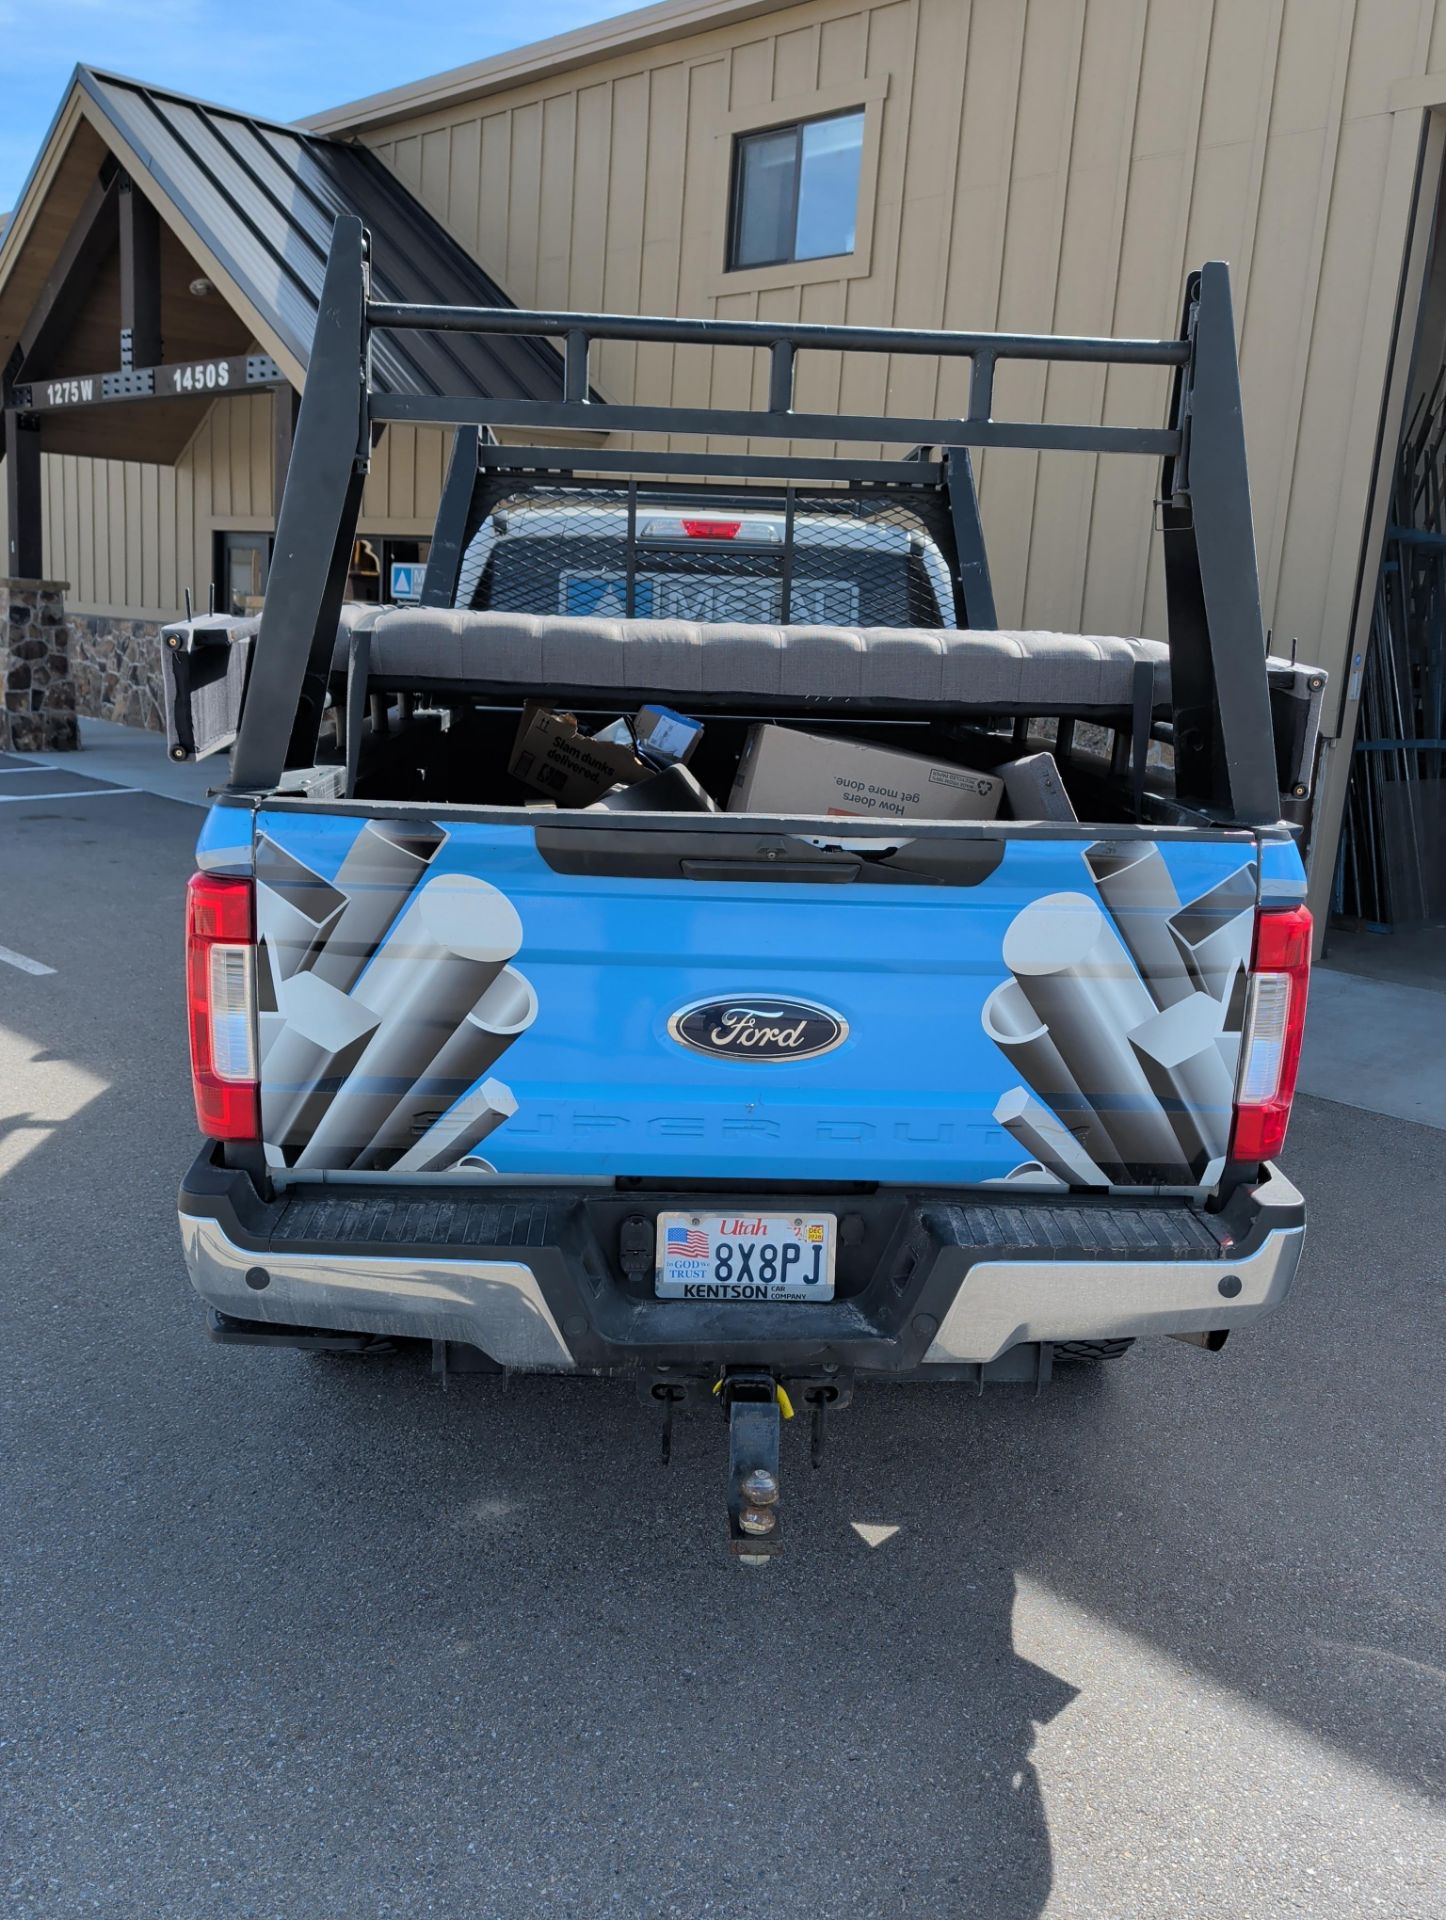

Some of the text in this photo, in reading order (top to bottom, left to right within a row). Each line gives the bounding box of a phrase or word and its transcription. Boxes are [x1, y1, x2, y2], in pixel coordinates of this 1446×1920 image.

[173, 361, 229, 393] 1450S
[547, 748, 600, 784] delivered.
[552, 735, 616, 776] Slam dunks
[833, 775, 920, 804] get more done.
[843, 791, 905, 816] How doers
[711, 1008, 808, 1047] Ford
[411, 1108, 782, 1145] SUPER
[719, 1217, 769, 1236] Utah
[669, 1269, 707, 1279] TRUST
[674, 1259, 700, 1269] GOD
[714, 1242, 823, 1285] 8X8PJ
[684, 1284, 768, 1300] KENTSON
